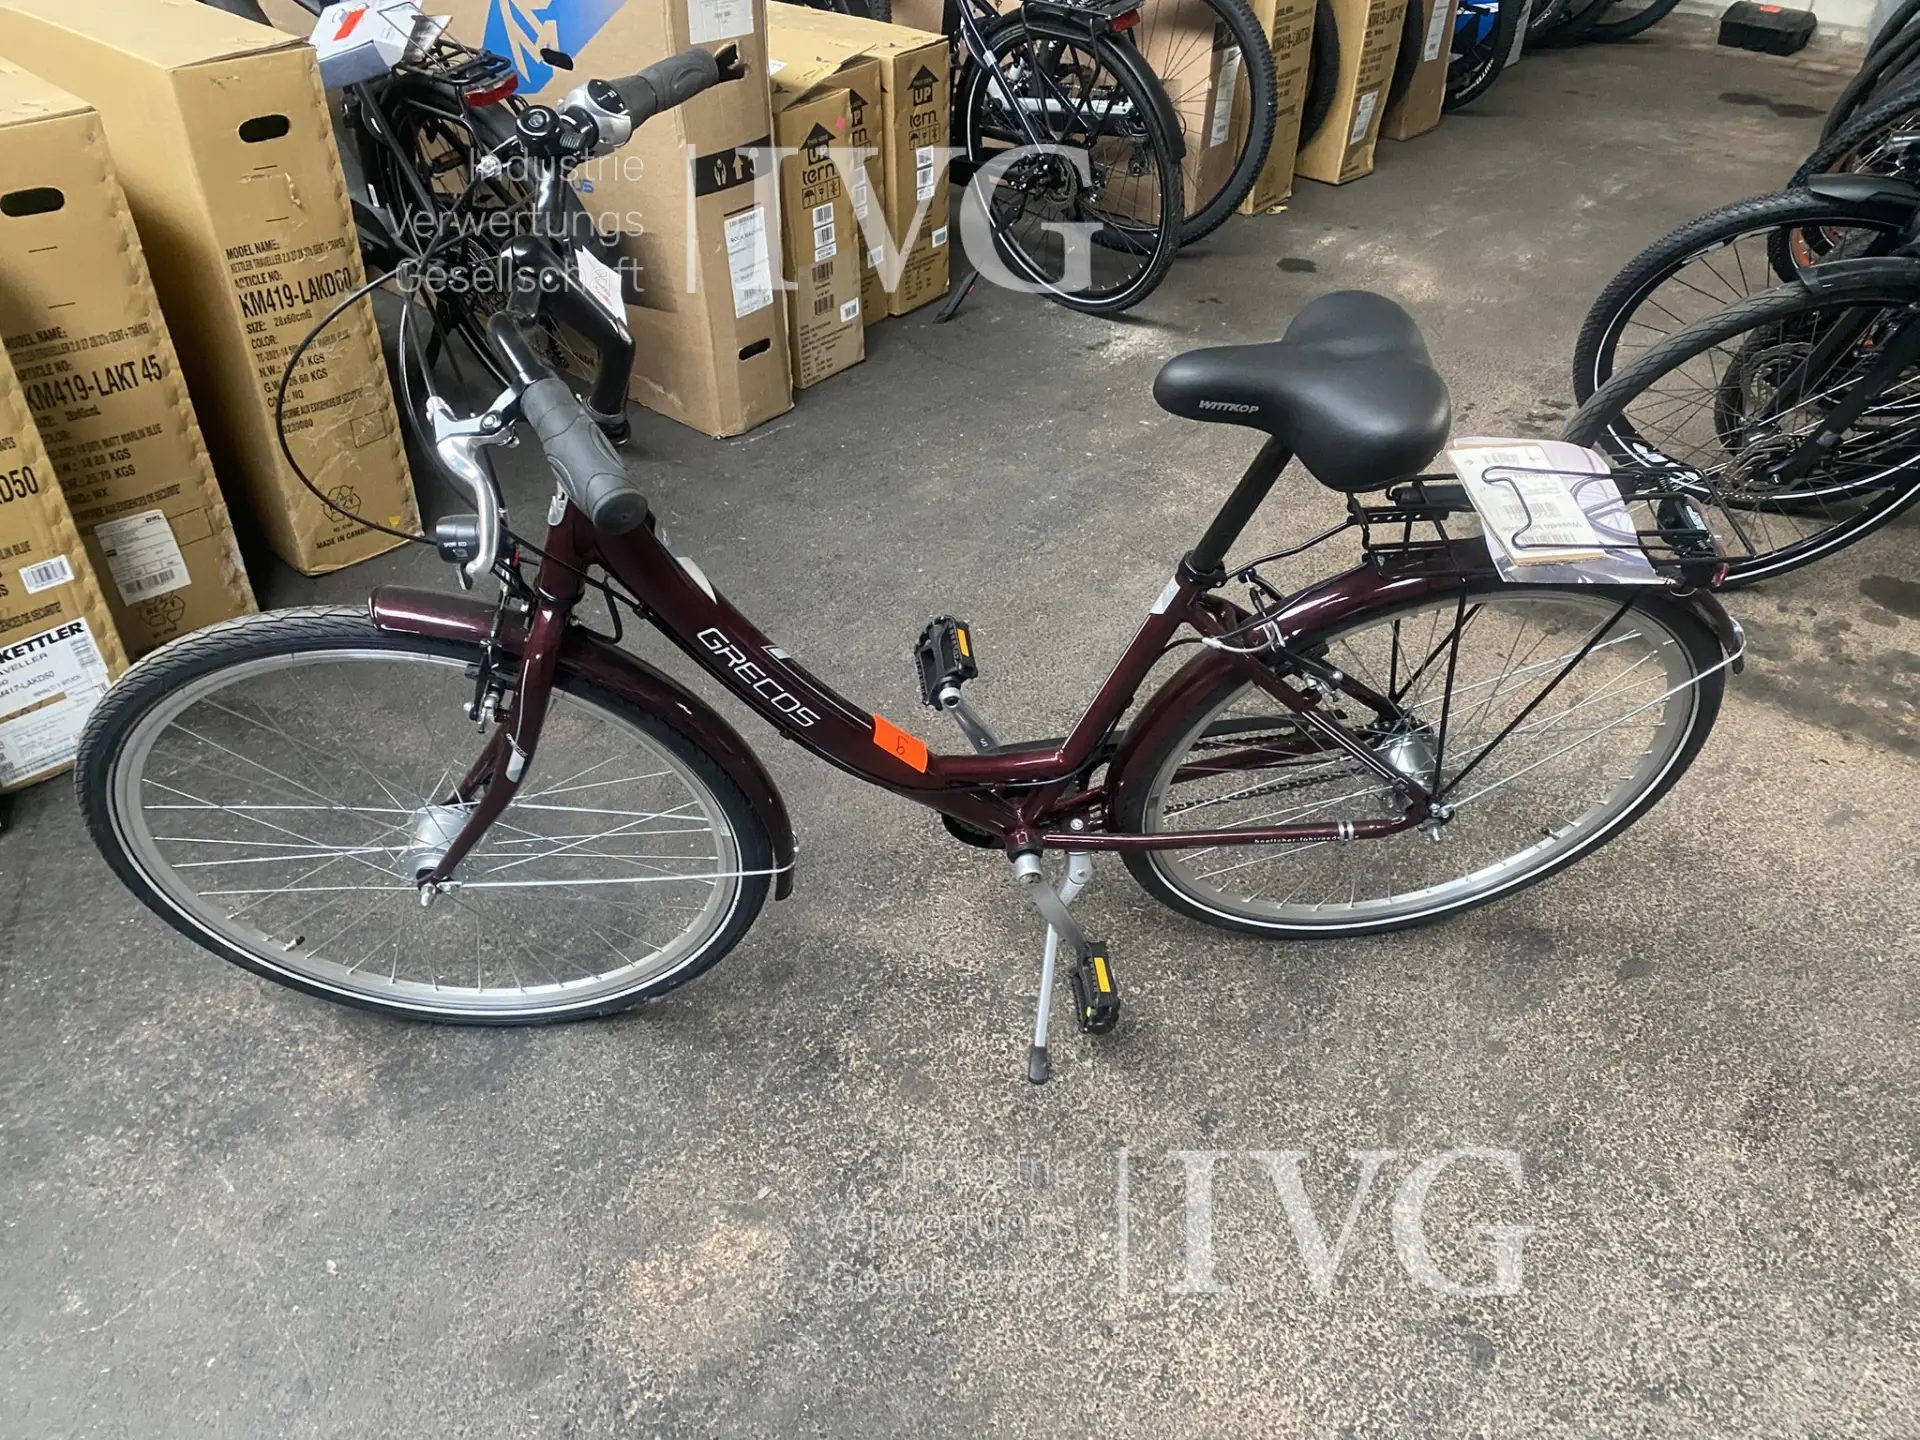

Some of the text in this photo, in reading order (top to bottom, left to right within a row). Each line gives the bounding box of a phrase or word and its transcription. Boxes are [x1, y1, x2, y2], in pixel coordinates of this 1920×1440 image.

[914, 87, 931, 103] UP
[909, 110, 937, 129] tern
[802, 162, 835, 186] tern
[225, 239, 280, 260] MODEL NAME:
[36, 326, 68, 342] NAME:
[246, 320, 267, 334] SIZE:
[251, 335, 278, 350] COLOR:
[311, 368, 329, 381] KGS
[1199, 400, 1259, 413] WITTKOP
[109, 448, 131, 463] KGS
[115, 464, 136, 479] KGS
[316, 538, 337, 549] MADE
[0, 621, 84, 664] KETTLER
[697, 627, 821, 728] GRECOS
